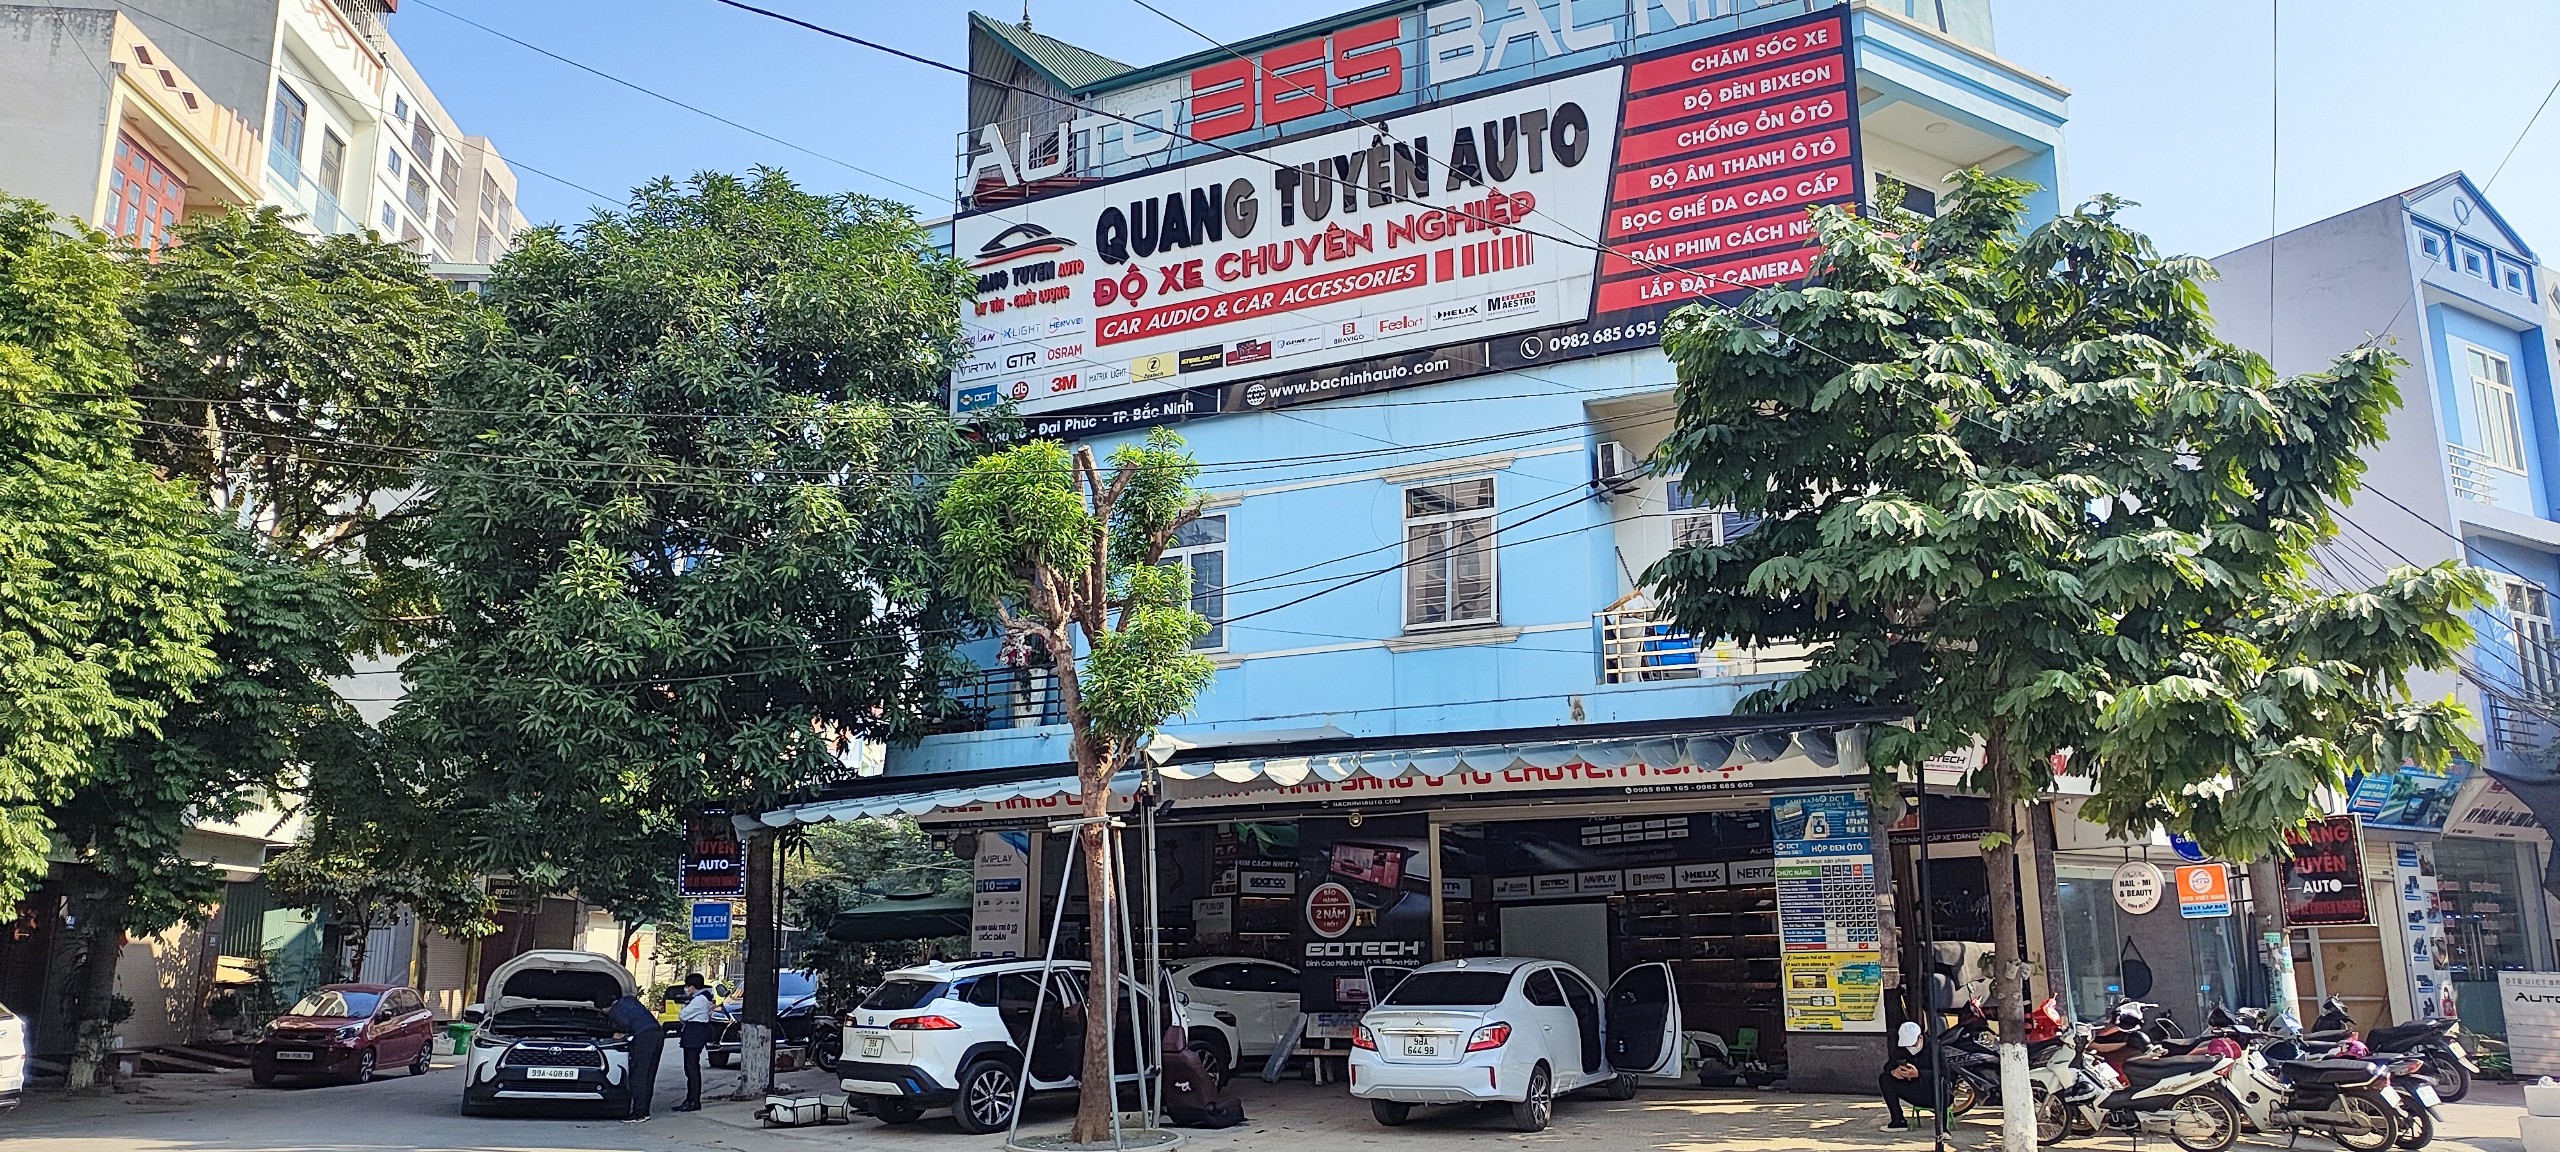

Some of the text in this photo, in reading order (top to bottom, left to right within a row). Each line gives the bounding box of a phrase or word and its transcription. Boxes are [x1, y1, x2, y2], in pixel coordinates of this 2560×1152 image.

[1691, 28, 1828, 73] CHĂM SÓC XE
[1683, 65, 1831, 112] ĐỘ ĐÈN BIXEON
[961, 99, 1176, 197] AUTO
[1190, 17, 1402, 144] 365
[1678, 116, 1749, 147] CHỐNG
[1095, 177, 1258, 266] QUANG
[1446, 101, 1589, 191] AUTO
[1649, 165, 1679, 190] ĐỘ
[1684, 157, 1715, 182] ÂM
[1721, 149, 1785, 176] THANH
[1621, 172, 1839, 232] BỌC GHẾ DA CAO CẤP
[1093, 187, 1537, 307] ĐỘ XE CHUYÊN NGHIỆP
[1674, 236, 1721, 258] PHIM
[1727, 222, 1783, 247] CÁCH
[977, 270, 1009, 293] ANG
[1058, 259, 1085, 277] AUTO
[1640, 276, 1673, 300] LẮP
[1722, 259, 1804, 285] CAMERA
[1102, 265, 1418, 340] CAR AUDIO & CAR ACCESSORIES
[1443, 304, 1479, 321] HELIX
[1047, 343, 1083, 360] OSRAM
[1549, 321, 1657, 352] 0982 685 695
[1006, 351, 1037, 369] GTR
[1051, 374, 1078, 393] 3M
[1269, 357, 1450, 400] www.bacninhauto.com
[1039, 421, 1061, 437] Đại
[1065, 415, 1097, 433] Phúc
[1133, 403, 1161, 422] Bắc
[1164, 400, 1194, 416] Ninh
[1925, 755, 1966, 764] OTECH
[698, 859, 729, 870] AUTO
[1690, 869, 1719, 880] HELIX
[2126, 889, 2153, 897] BEAUTY
[2303, 879, 2343, 894] AUTO
[694, 915, 727, 924] NTECH
[1316, 910, 1322, 919] 2
[1306, 941, 1419, 956] GOTECH
